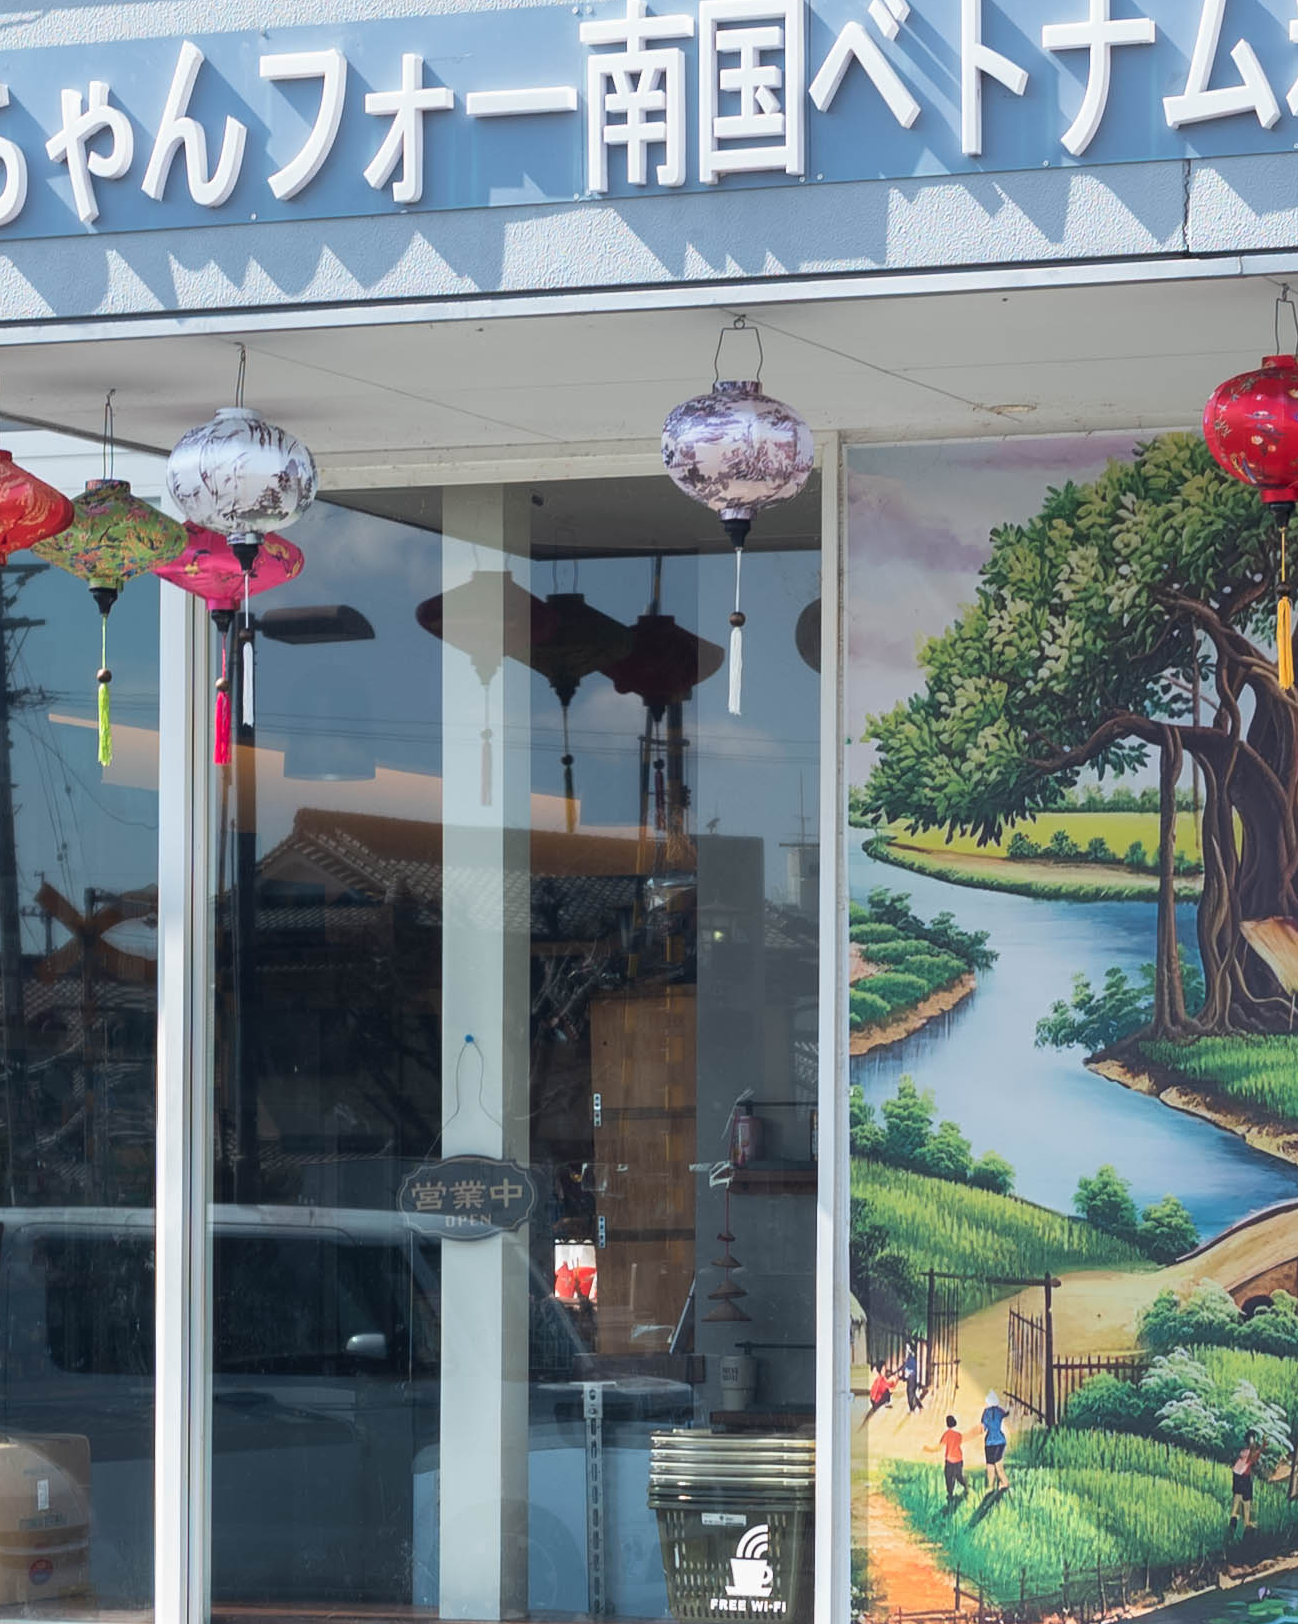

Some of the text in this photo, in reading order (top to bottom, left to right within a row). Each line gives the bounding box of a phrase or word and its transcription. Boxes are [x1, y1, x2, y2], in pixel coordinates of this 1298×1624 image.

[412, 1178, 523, 1211] 営業中
[445, 1214, 492, 1228] OPEN
[710, 1599, 747, 1612] FREE
